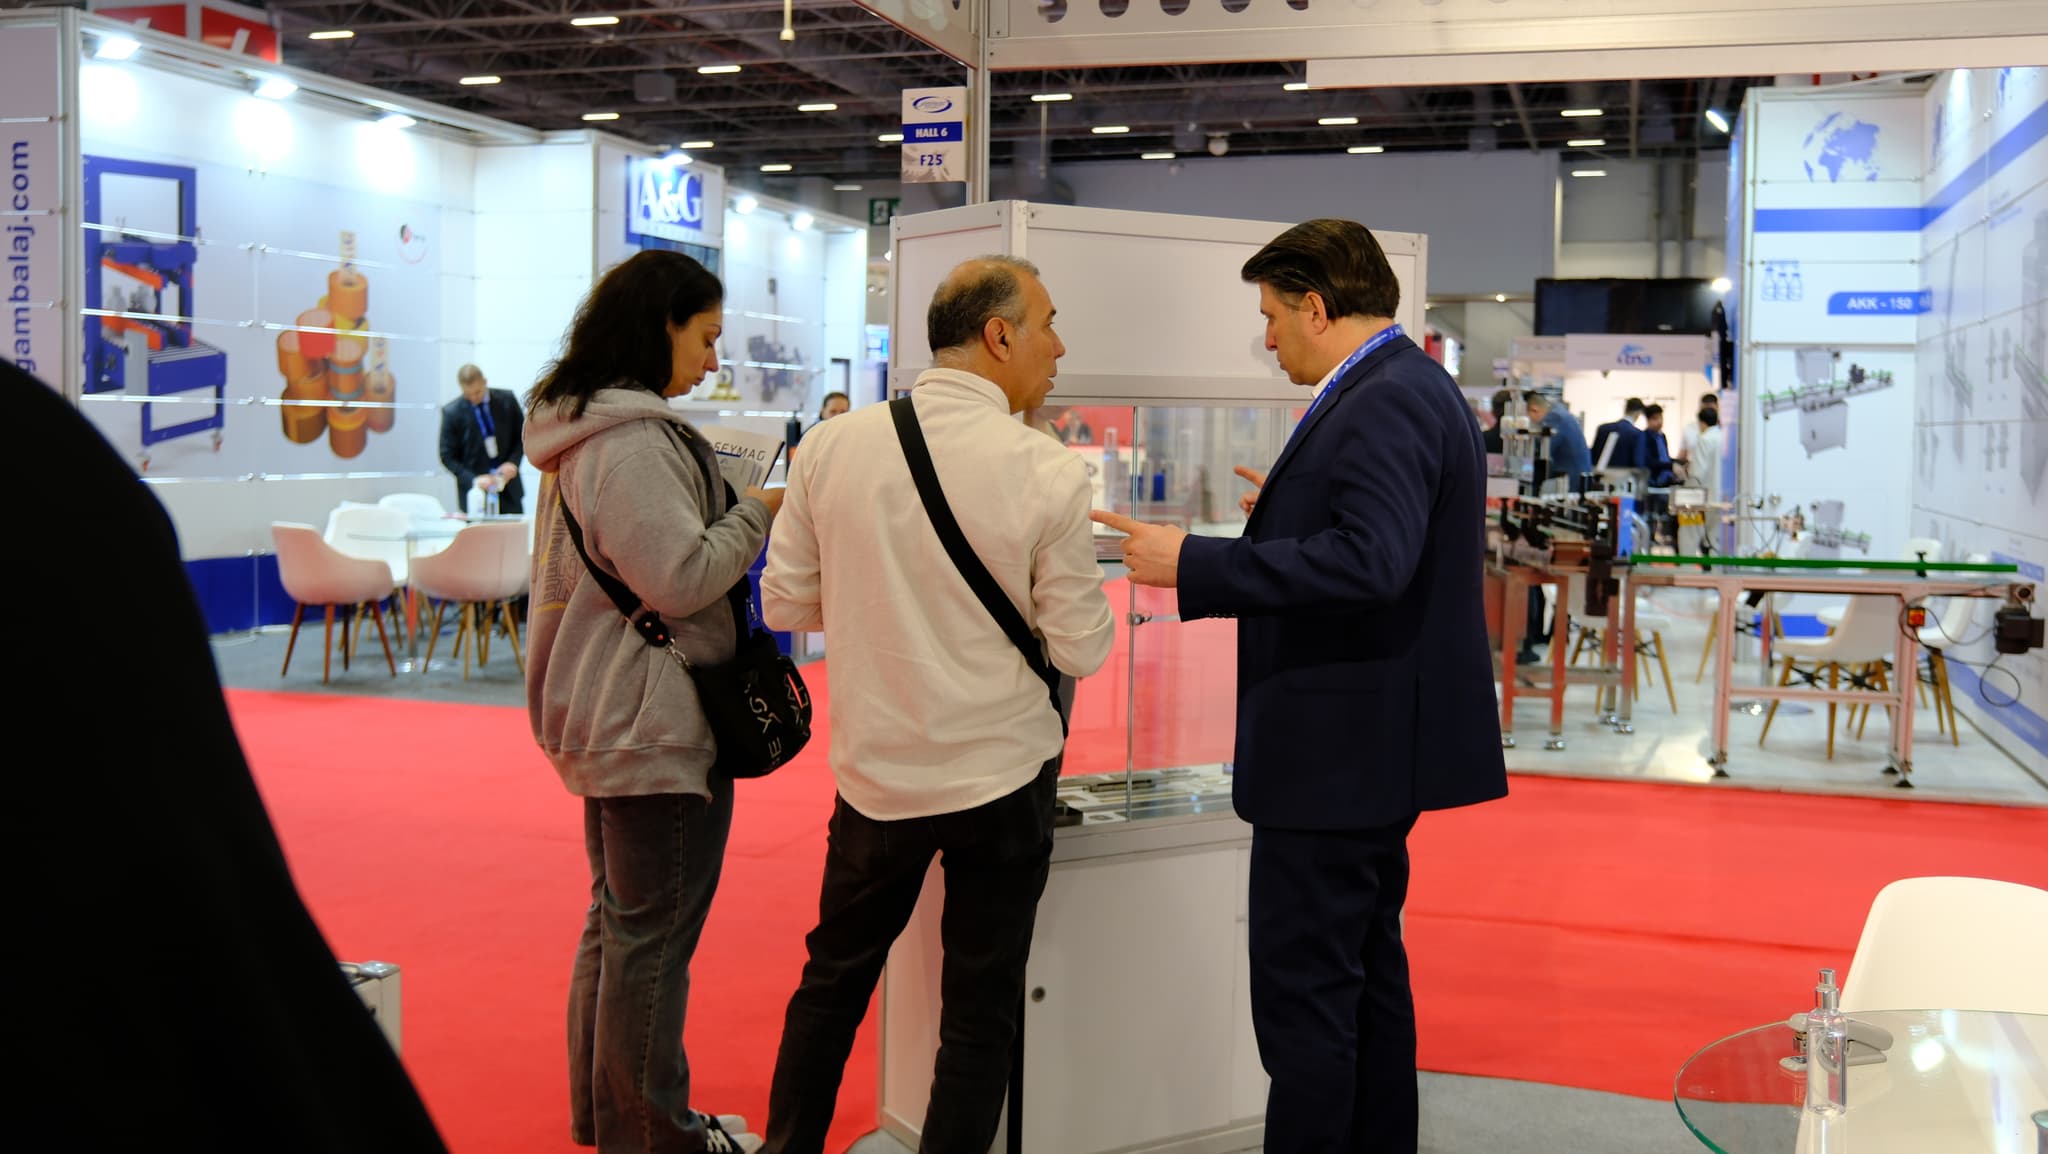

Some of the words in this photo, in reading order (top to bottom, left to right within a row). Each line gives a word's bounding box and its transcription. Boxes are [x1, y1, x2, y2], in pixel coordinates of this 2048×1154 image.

[915, 128, 938, 138] HALL
[940, 127, 948, 137] 6
[920, 154, 943, 166] F25
[639, 168, 702, 223] A&G
